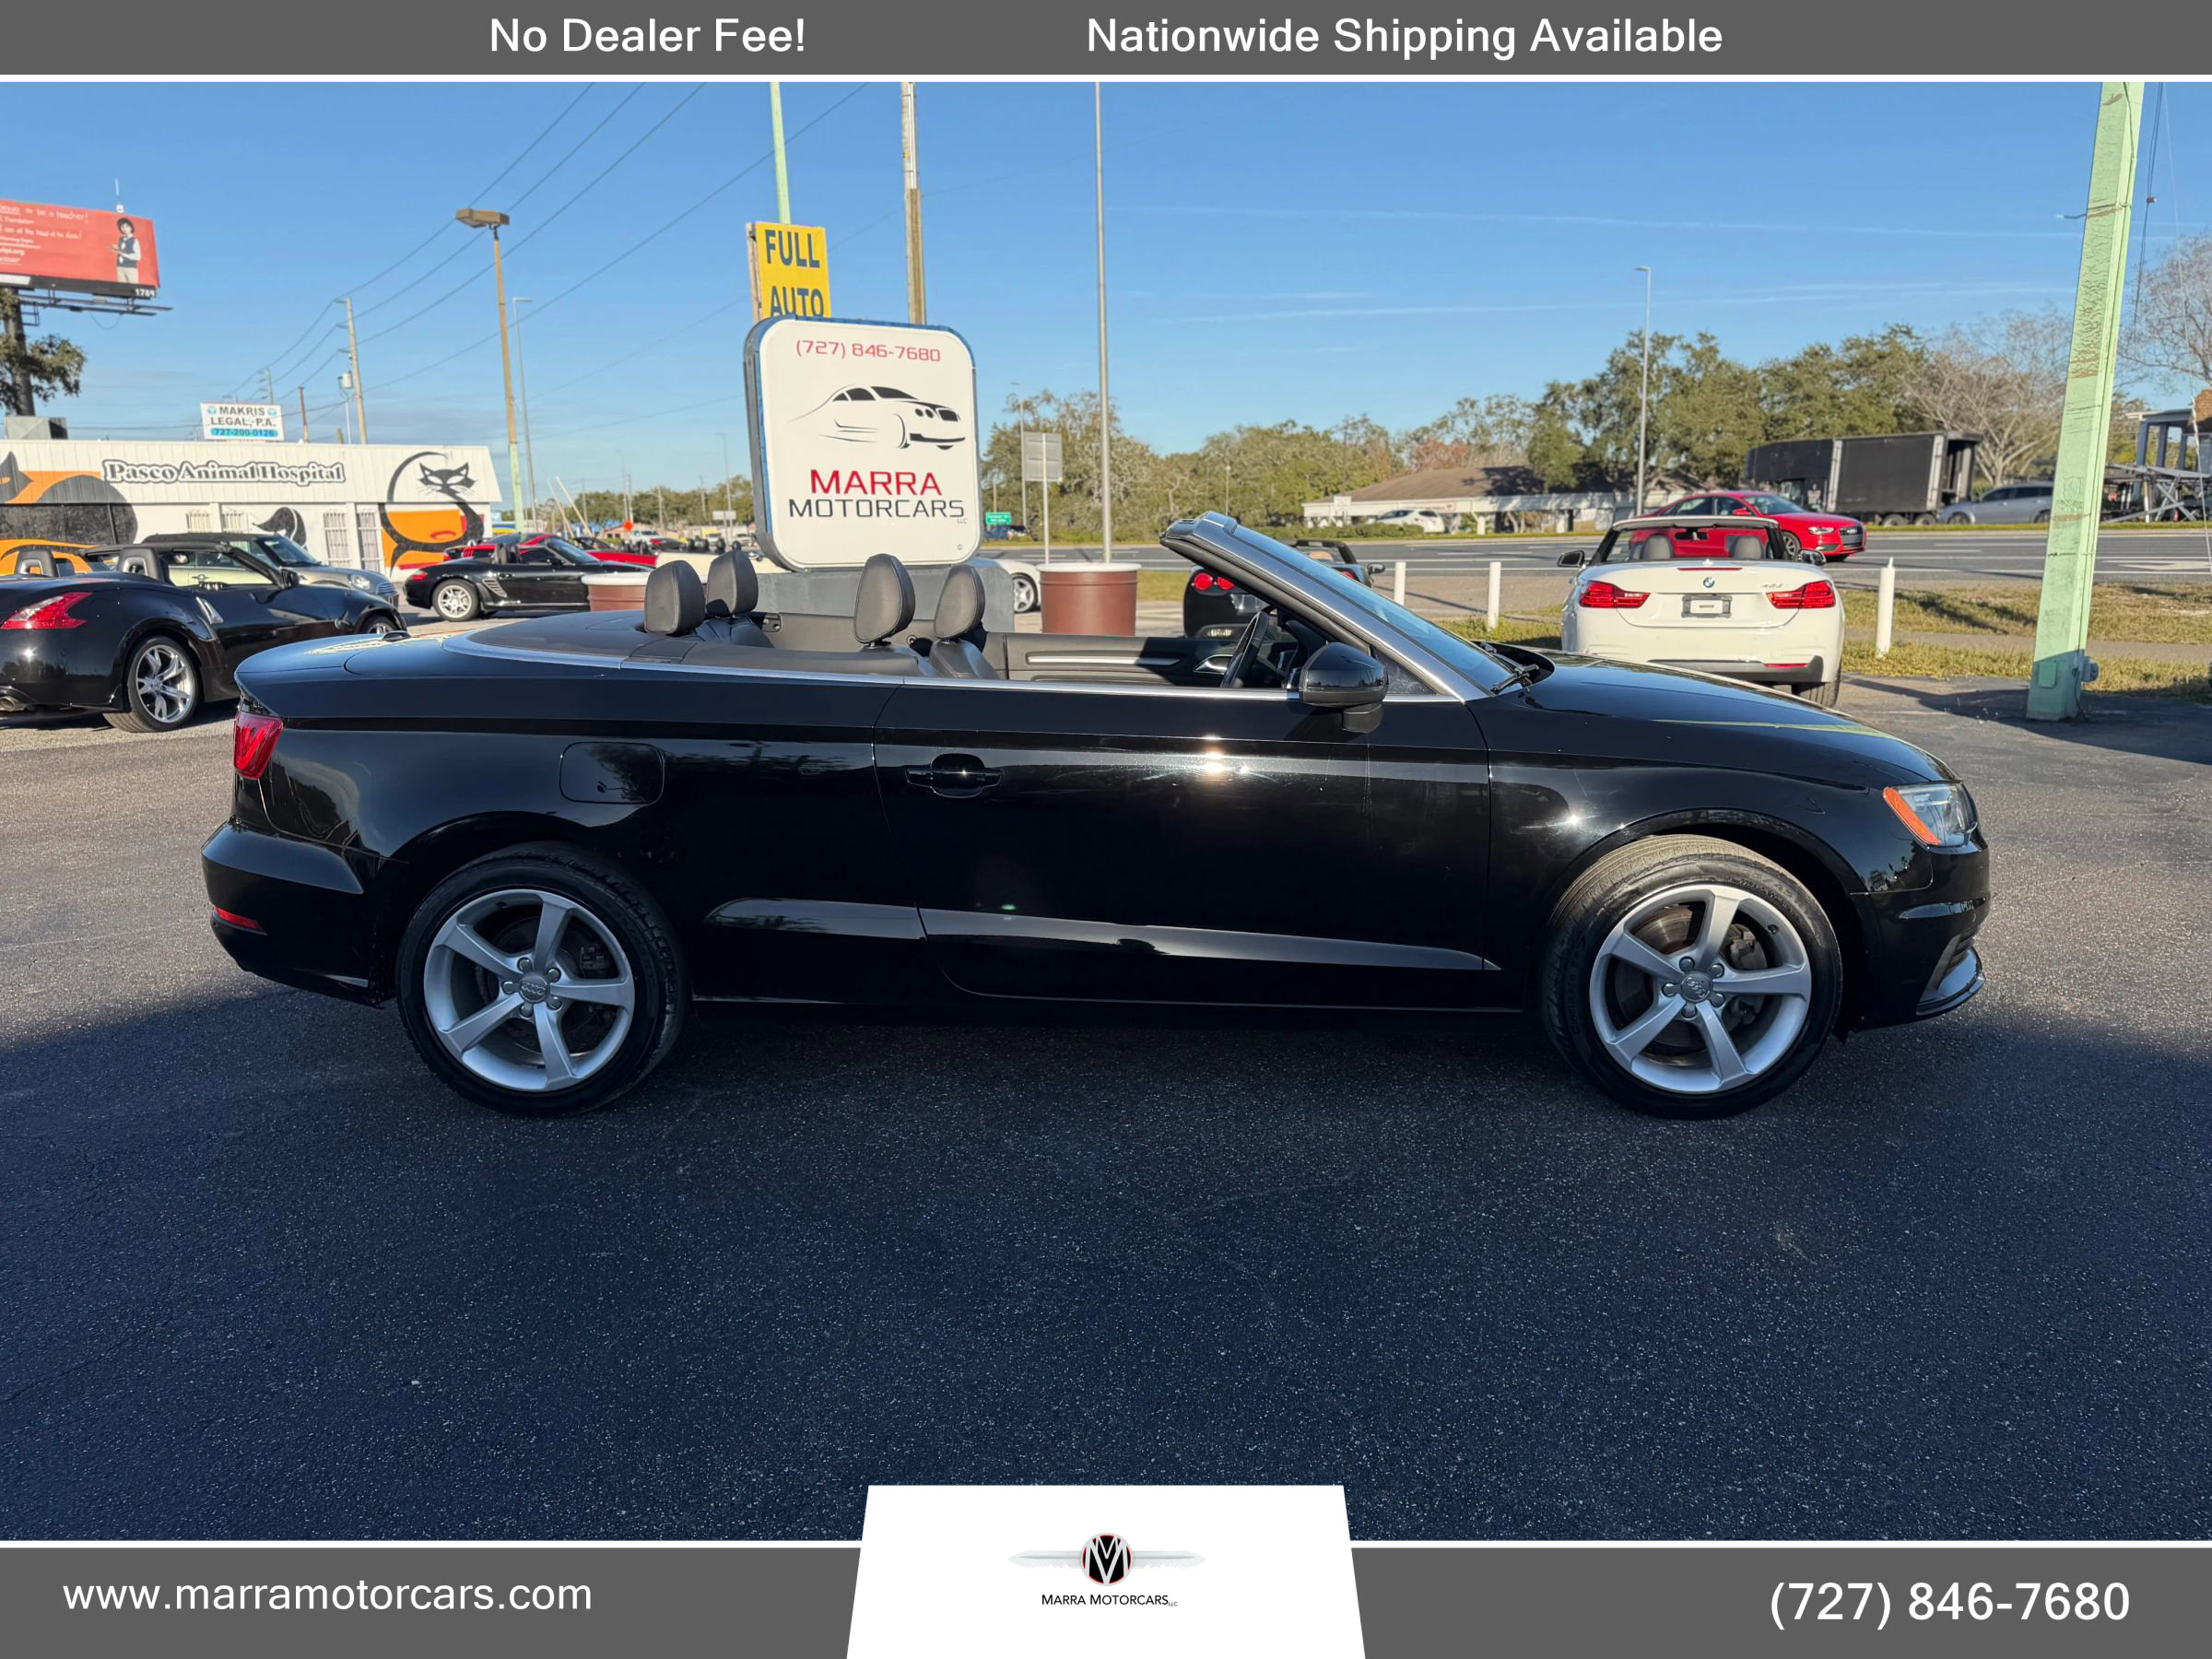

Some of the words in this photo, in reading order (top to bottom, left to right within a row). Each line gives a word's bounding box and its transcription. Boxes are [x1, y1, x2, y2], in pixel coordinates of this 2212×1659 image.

[765, 229, 820, 268] FULL
[771, 286, 824, 317] AUTO
[795, 338, 846, 359] (727)
[851, 342, 942, 363] 846-7680
[210, 417, 253, 428] LEGAL,
[255, 418, 276, 427] P.A.
[218, 406, 265, 417] MAKRIS
[106, 462, 177, 482] Pasco
[180, 462, 257, 482] Animal
[260, 462, 344, 485] Hospital
[810, 469, 943, 497] MARRA
[789, 499, 965, 518] MOTORCARS
